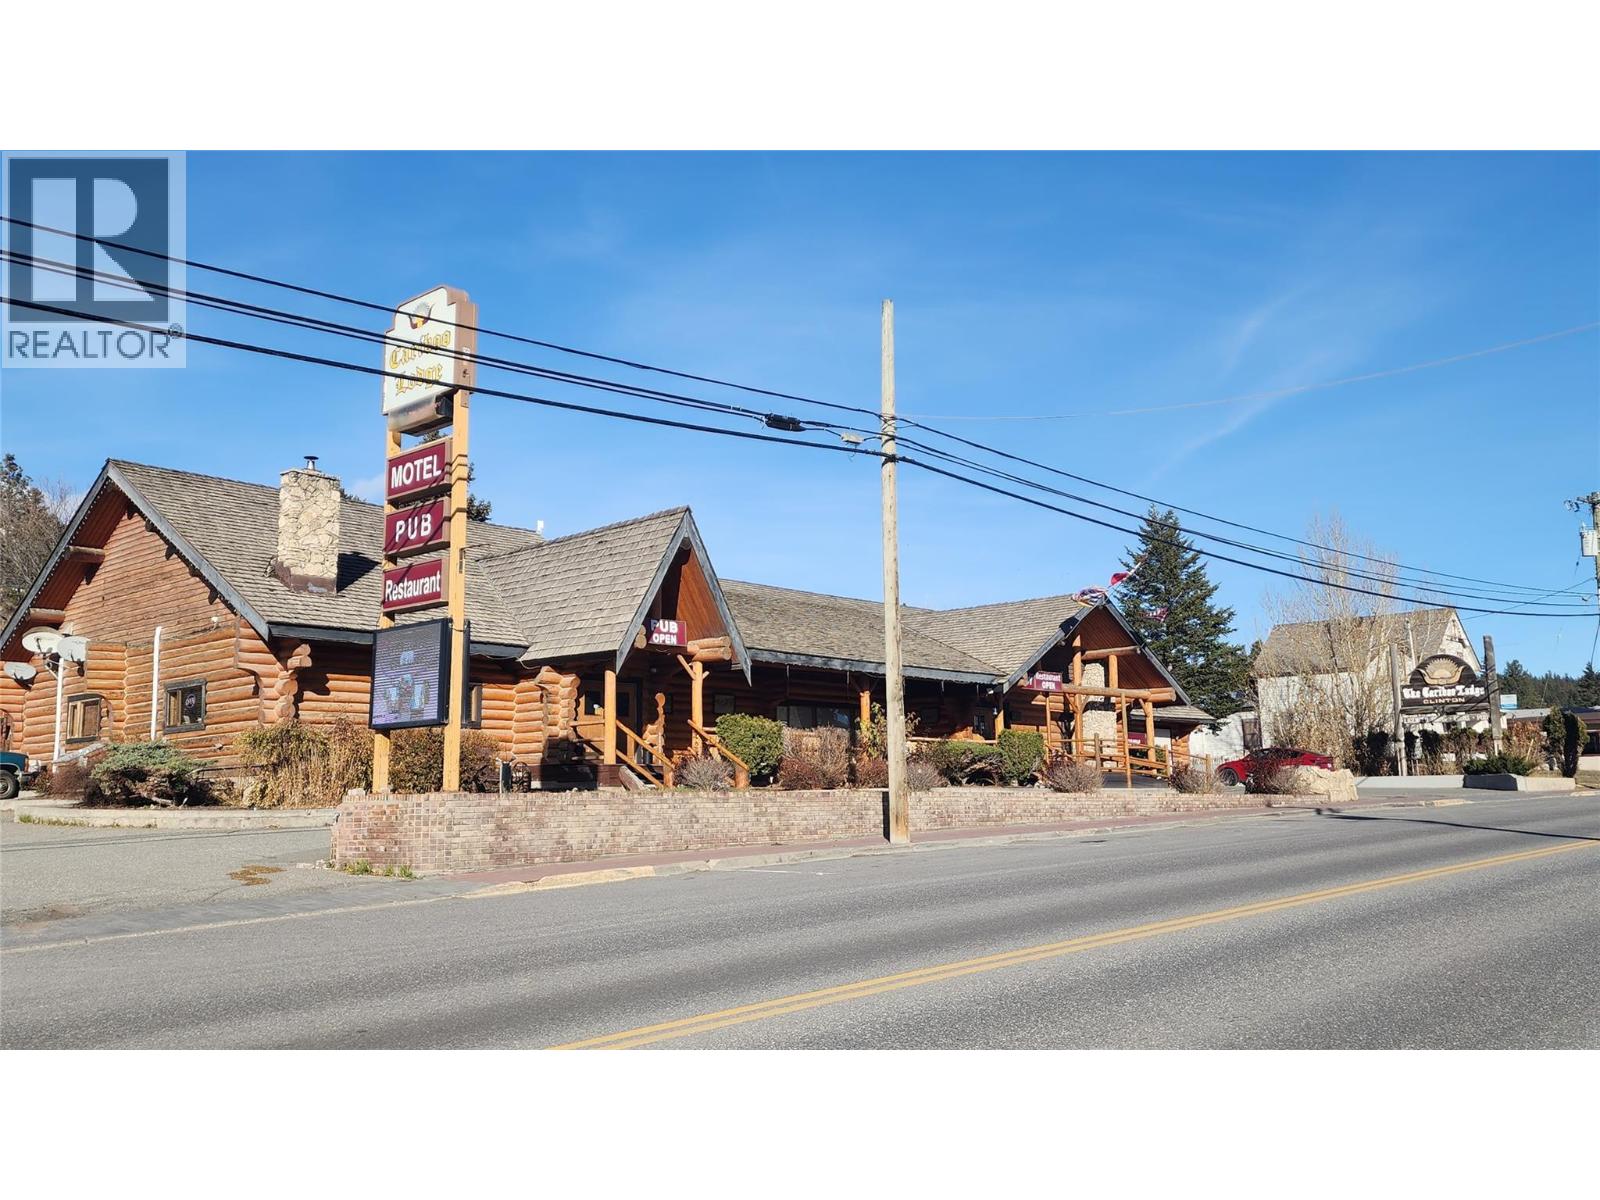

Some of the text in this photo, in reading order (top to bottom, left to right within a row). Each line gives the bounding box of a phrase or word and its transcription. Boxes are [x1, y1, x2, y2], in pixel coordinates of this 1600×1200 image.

[391, 454, 442, 489] MOTEL
[395, 513, 432, 543] PUB
[385, 570, 441, 602] Restaurant
[650, 619, 678, 633] PUB
[652, 633, 677, 645] OPEN
